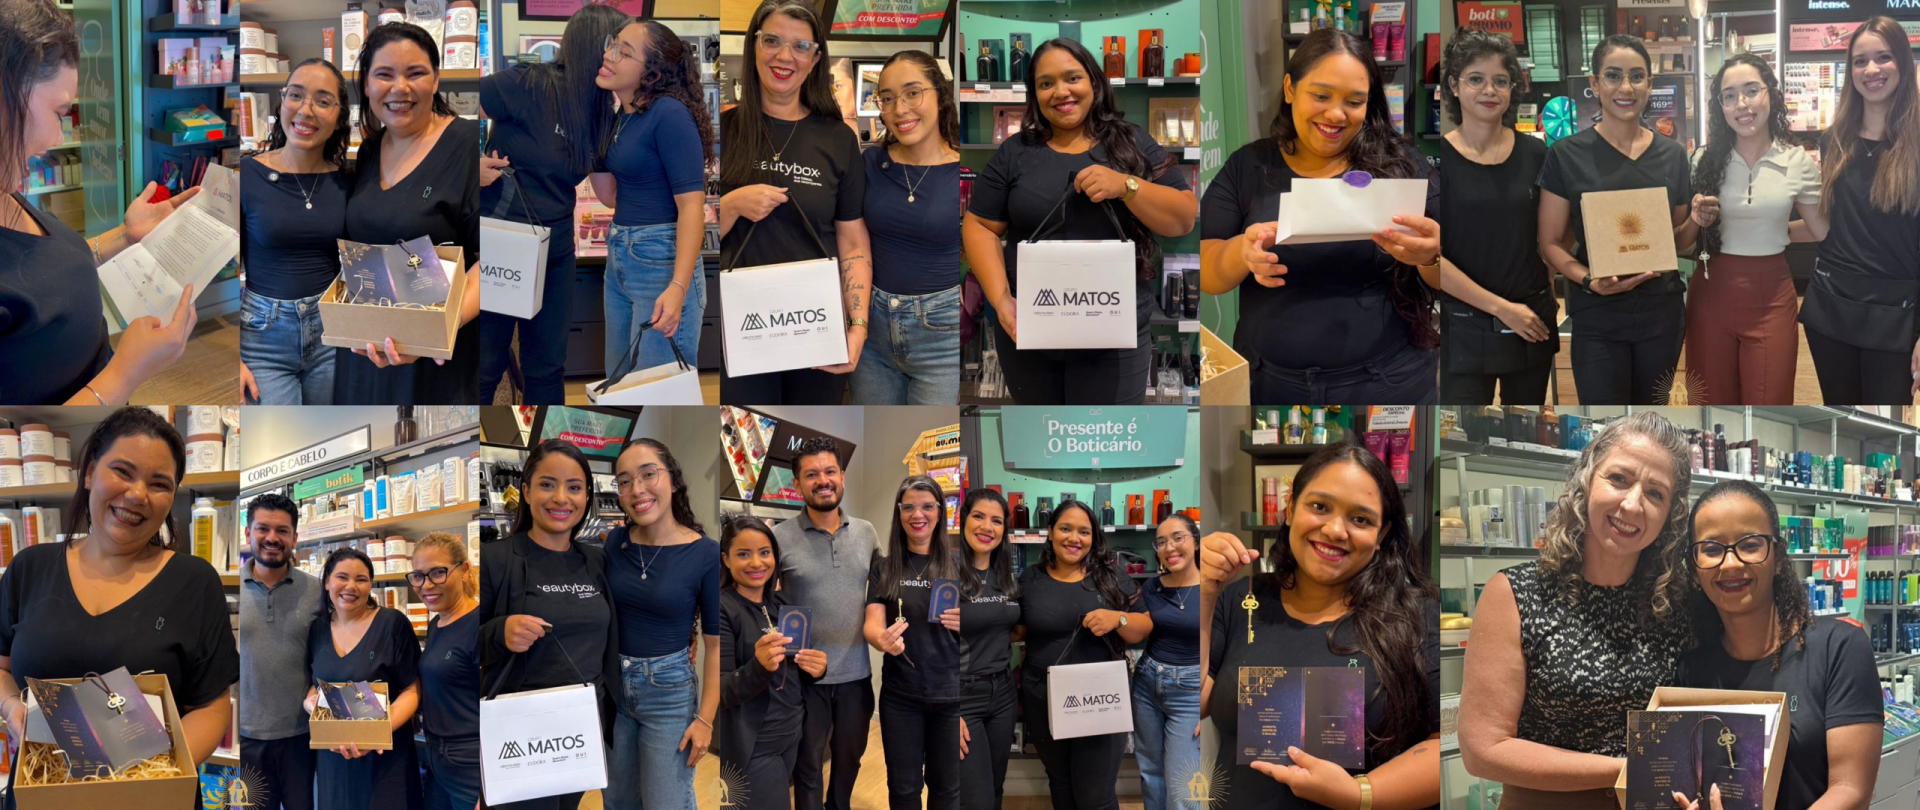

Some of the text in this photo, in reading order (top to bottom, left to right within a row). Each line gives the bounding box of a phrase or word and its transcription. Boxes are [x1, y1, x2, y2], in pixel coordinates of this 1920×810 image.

[871, 3, 913, 11] PREFERIDA
[1469, 8, 1496, 21] boti
[876, 16, 918, 24] DESCONTO!
[753, 160, 821, 178] eautybox
[1063, 291, 1120, 306] MATOS
[769, 308, 827, 328] MATOS
[1048, 417, 1138, 435] Presente é
[1048, 435, 1142, 453] O Boticário
[247, 447, 327, 482] CORPO E CABELO
[325, 472, 355, 489] botik
[537, 583, 595, 594] eautybox
[1083, 693, 1121, 706] MATOS
[528, 734, 585, 756] MATOS
